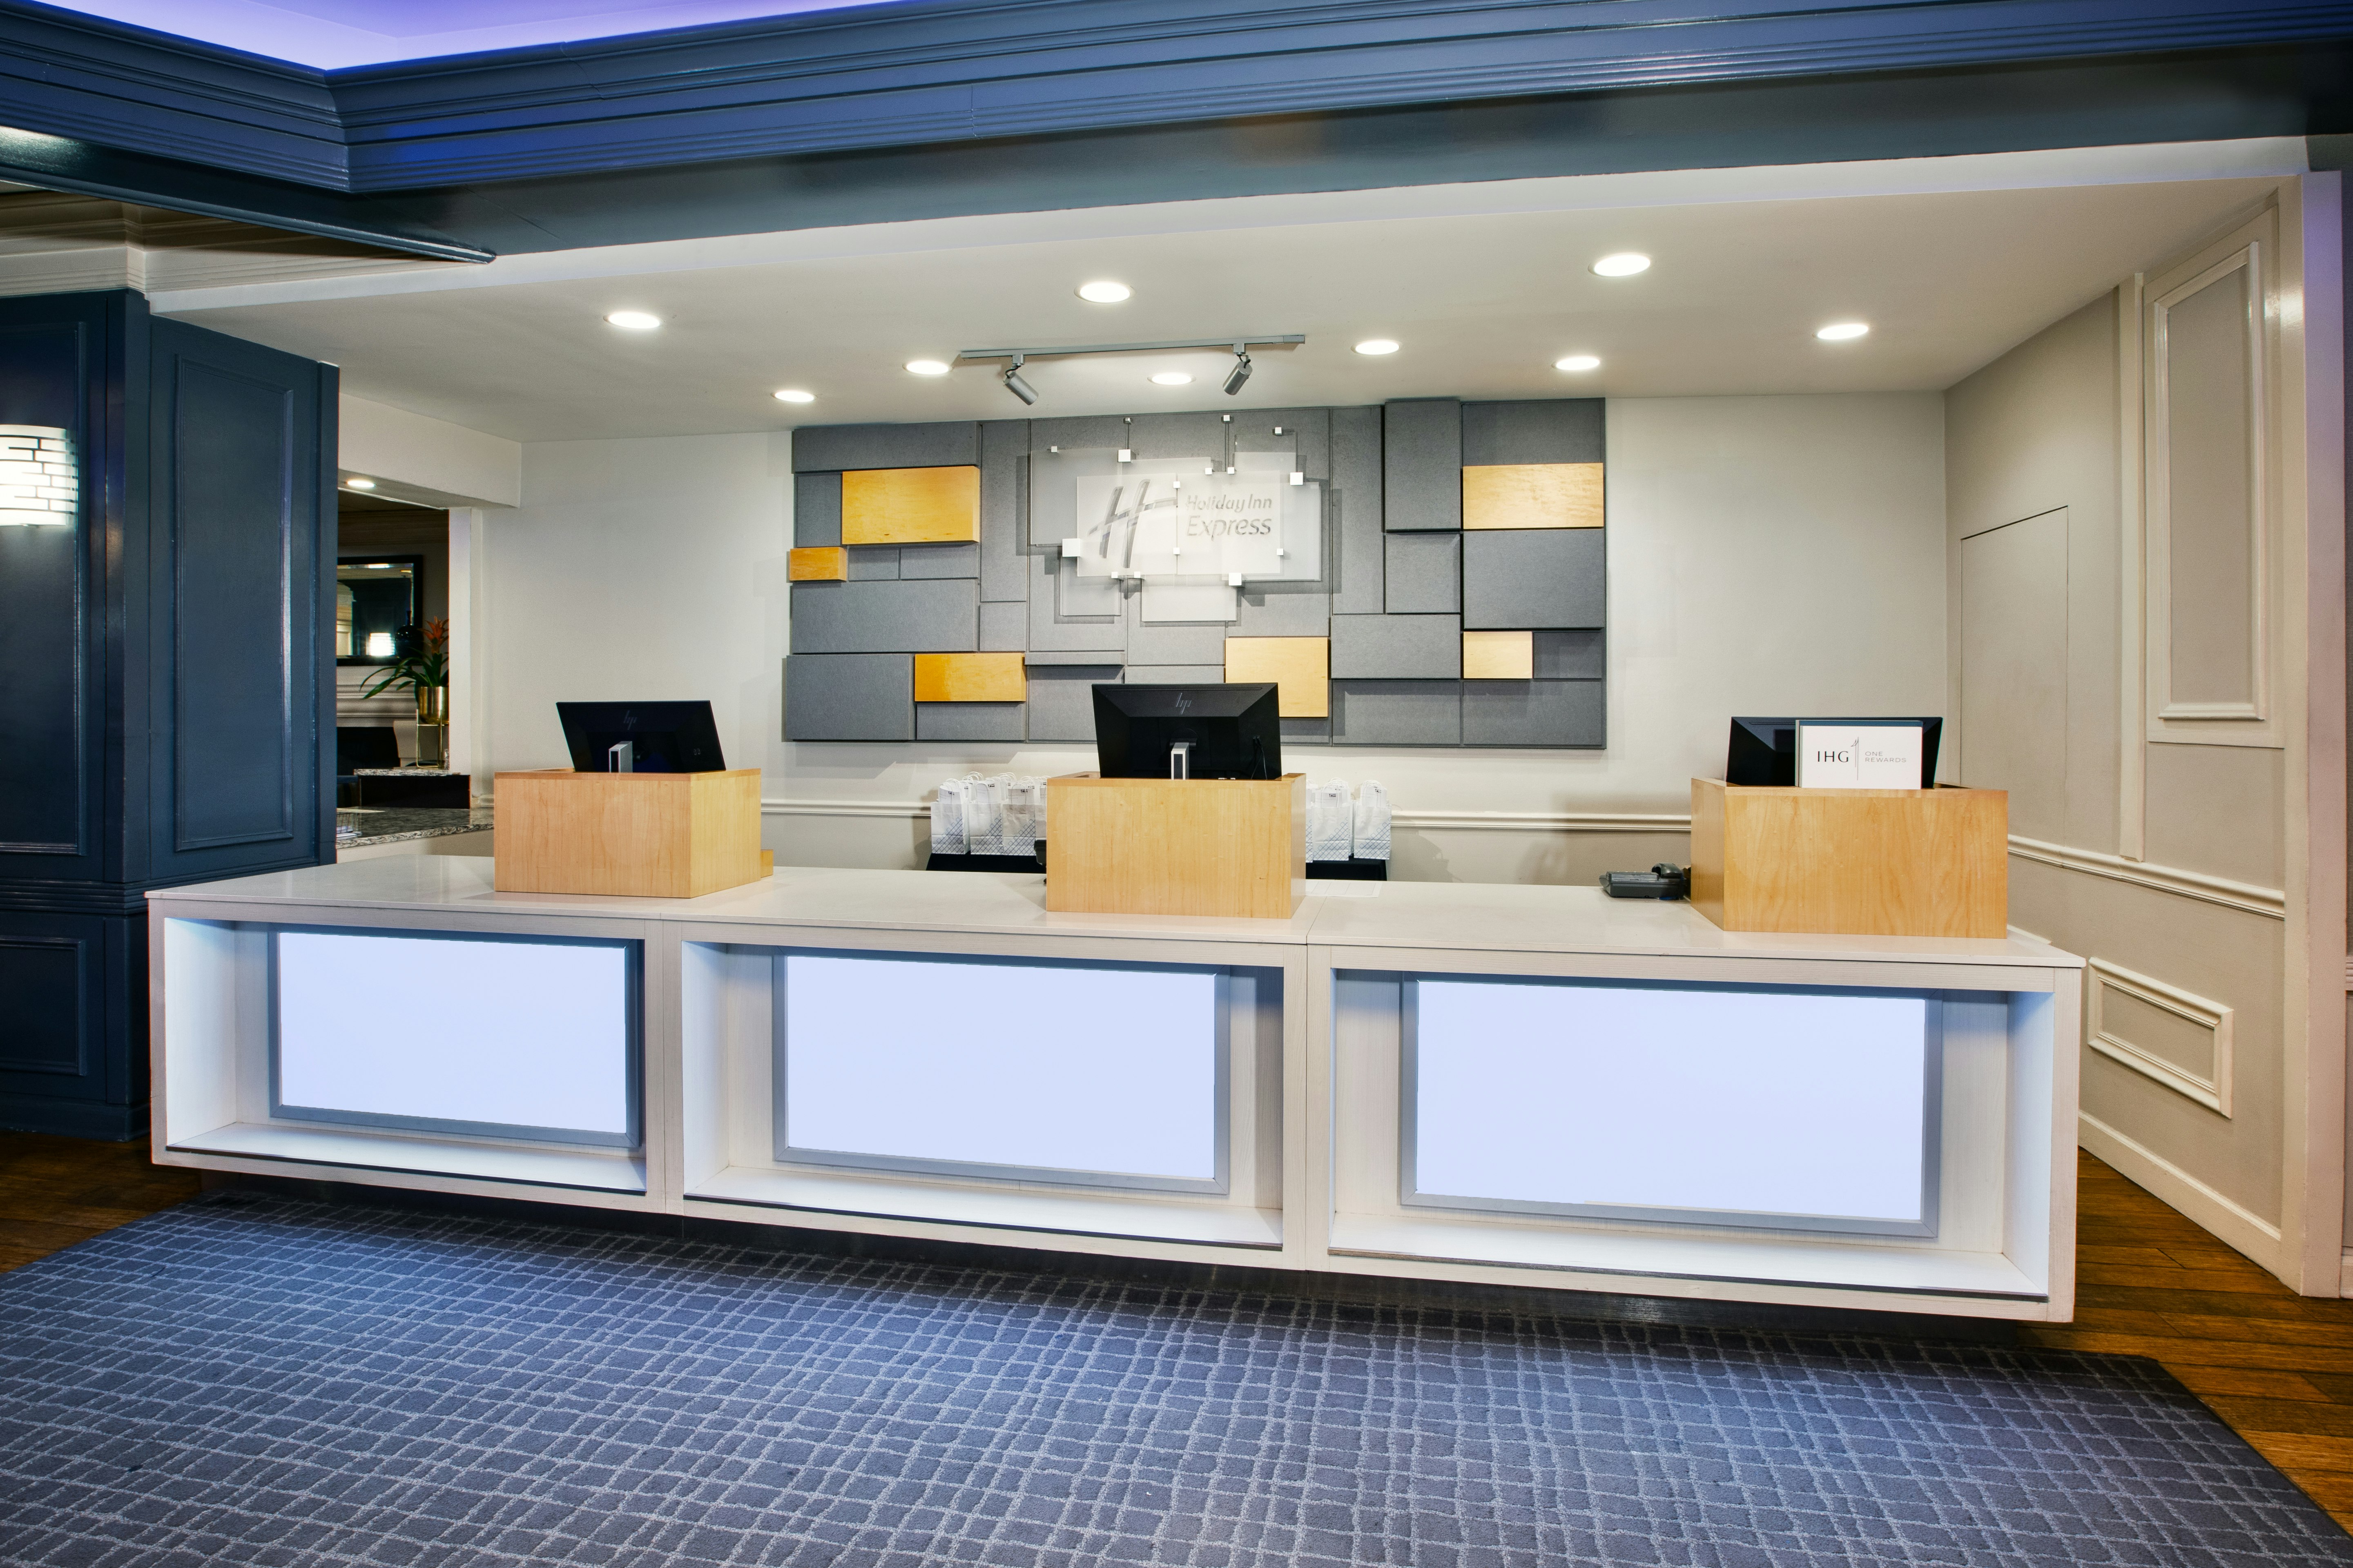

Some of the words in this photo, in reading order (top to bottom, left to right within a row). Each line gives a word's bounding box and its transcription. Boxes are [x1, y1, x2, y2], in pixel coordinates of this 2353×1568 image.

[1186, 494, 1245, 513] Holiday
[1248, 494, 1272, 509] Inn
[1187, 515, 1272, 541] Express
[1176, 692, 1191, 715] hp
[623, 710, 638, 730] hp
[1818, 751, 1849, 762] IHG
